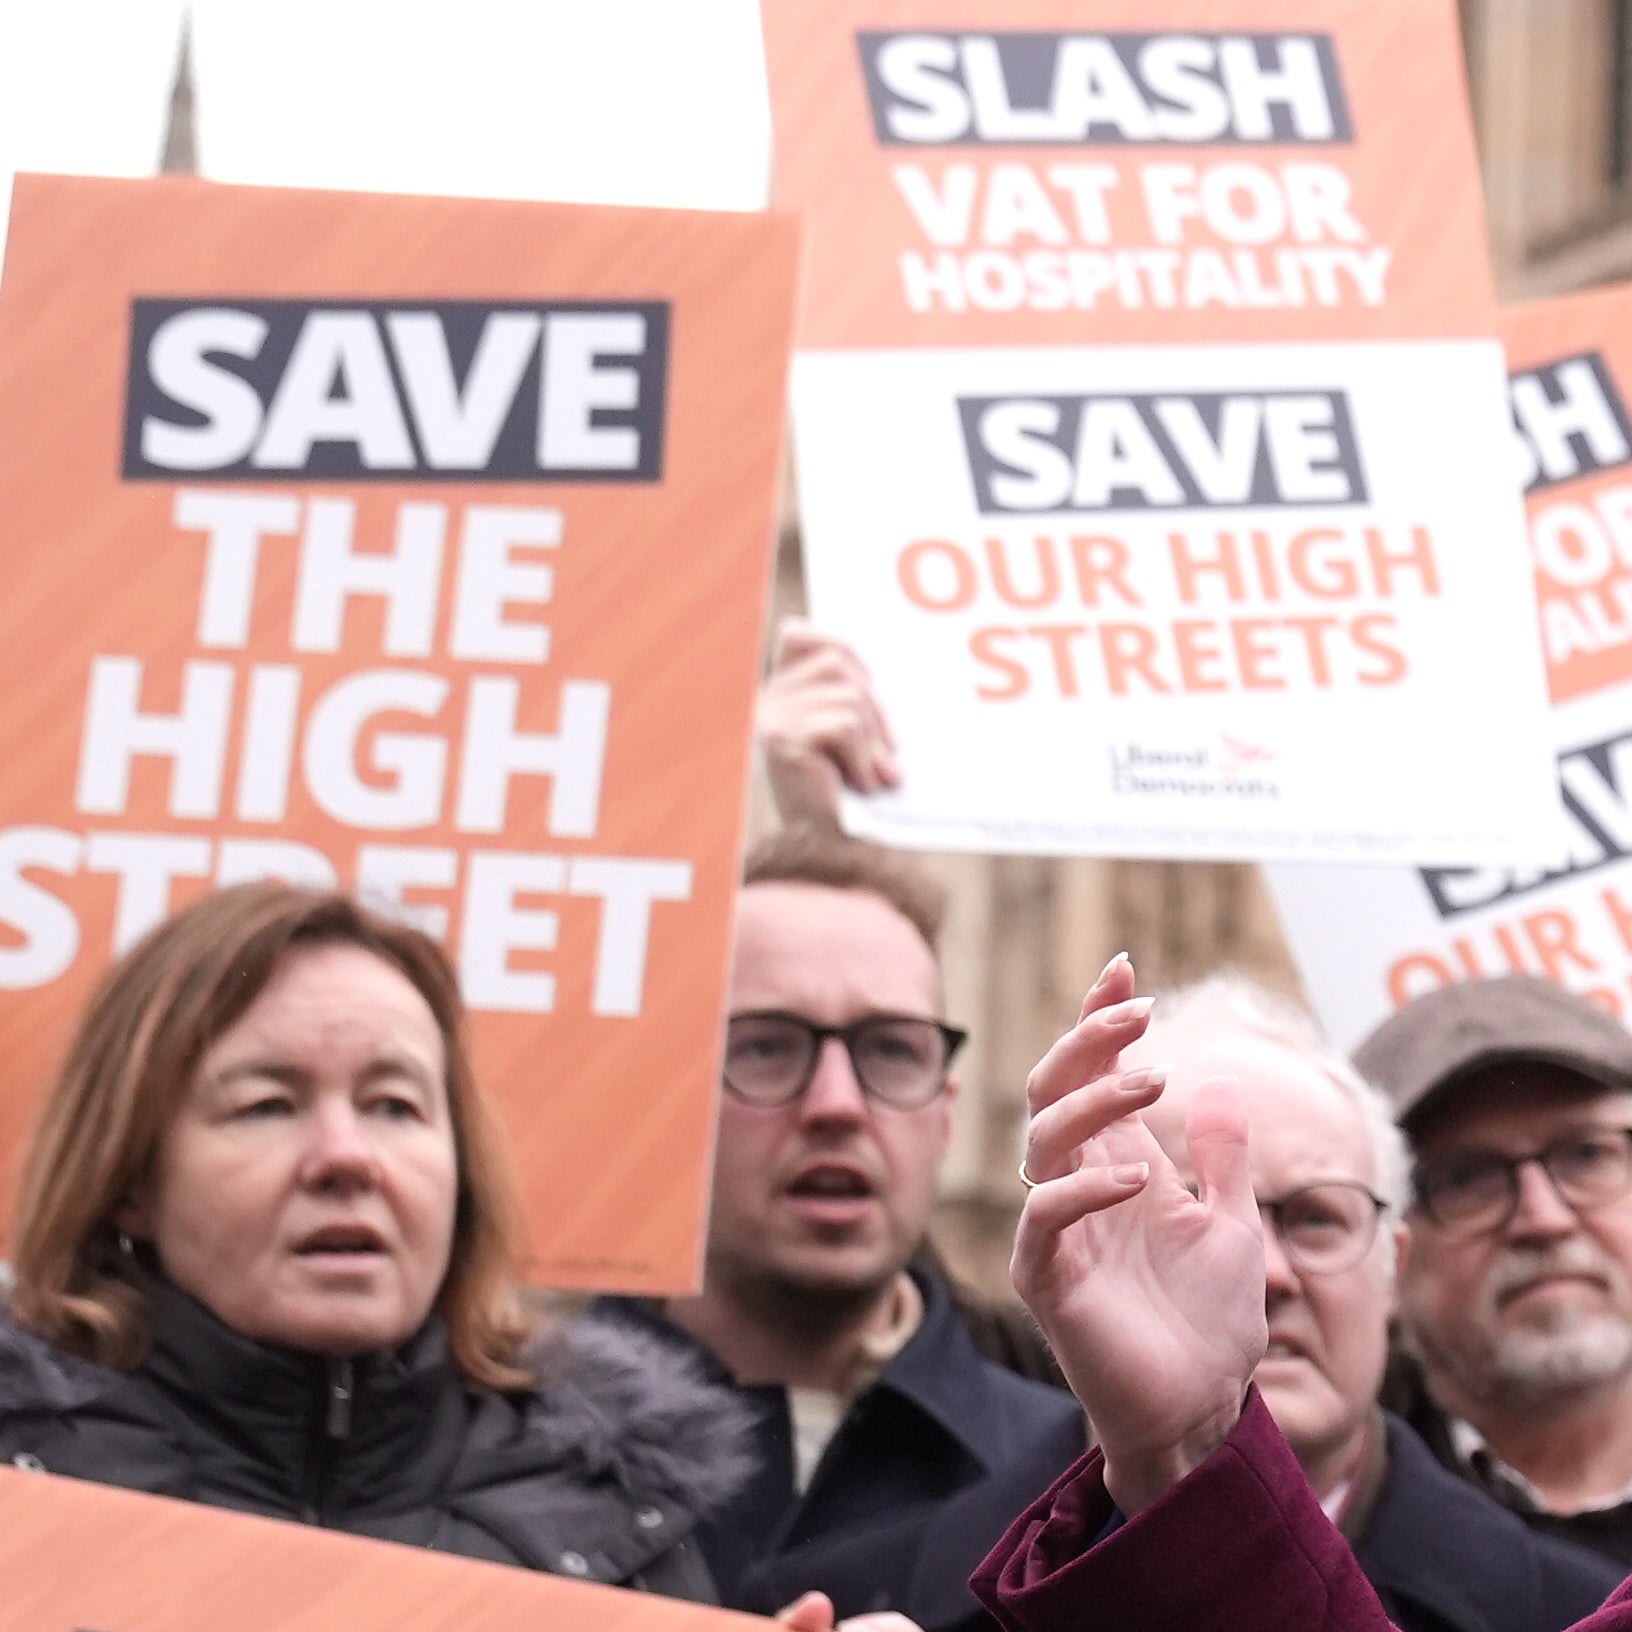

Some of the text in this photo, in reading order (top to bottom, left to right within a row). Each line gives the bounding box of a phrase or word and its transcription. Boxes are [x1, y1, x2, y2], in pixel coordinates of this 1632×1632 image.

[876, 34, 1336, 143] SLASH
[890, 162, 1366, 246] VAT FOR
[901, 247, 1391, 312] HOSPITALITY
[141, 310, 647, 469] SAVE
[979, 397, 1350, 510] SAVE
[173, 491, 564, 663] THE
[897, 525, 1441, 613] OUR HIGH
[969, 612, 1408, 702] STREETS
[74, 654, 610, 838] HIGH
